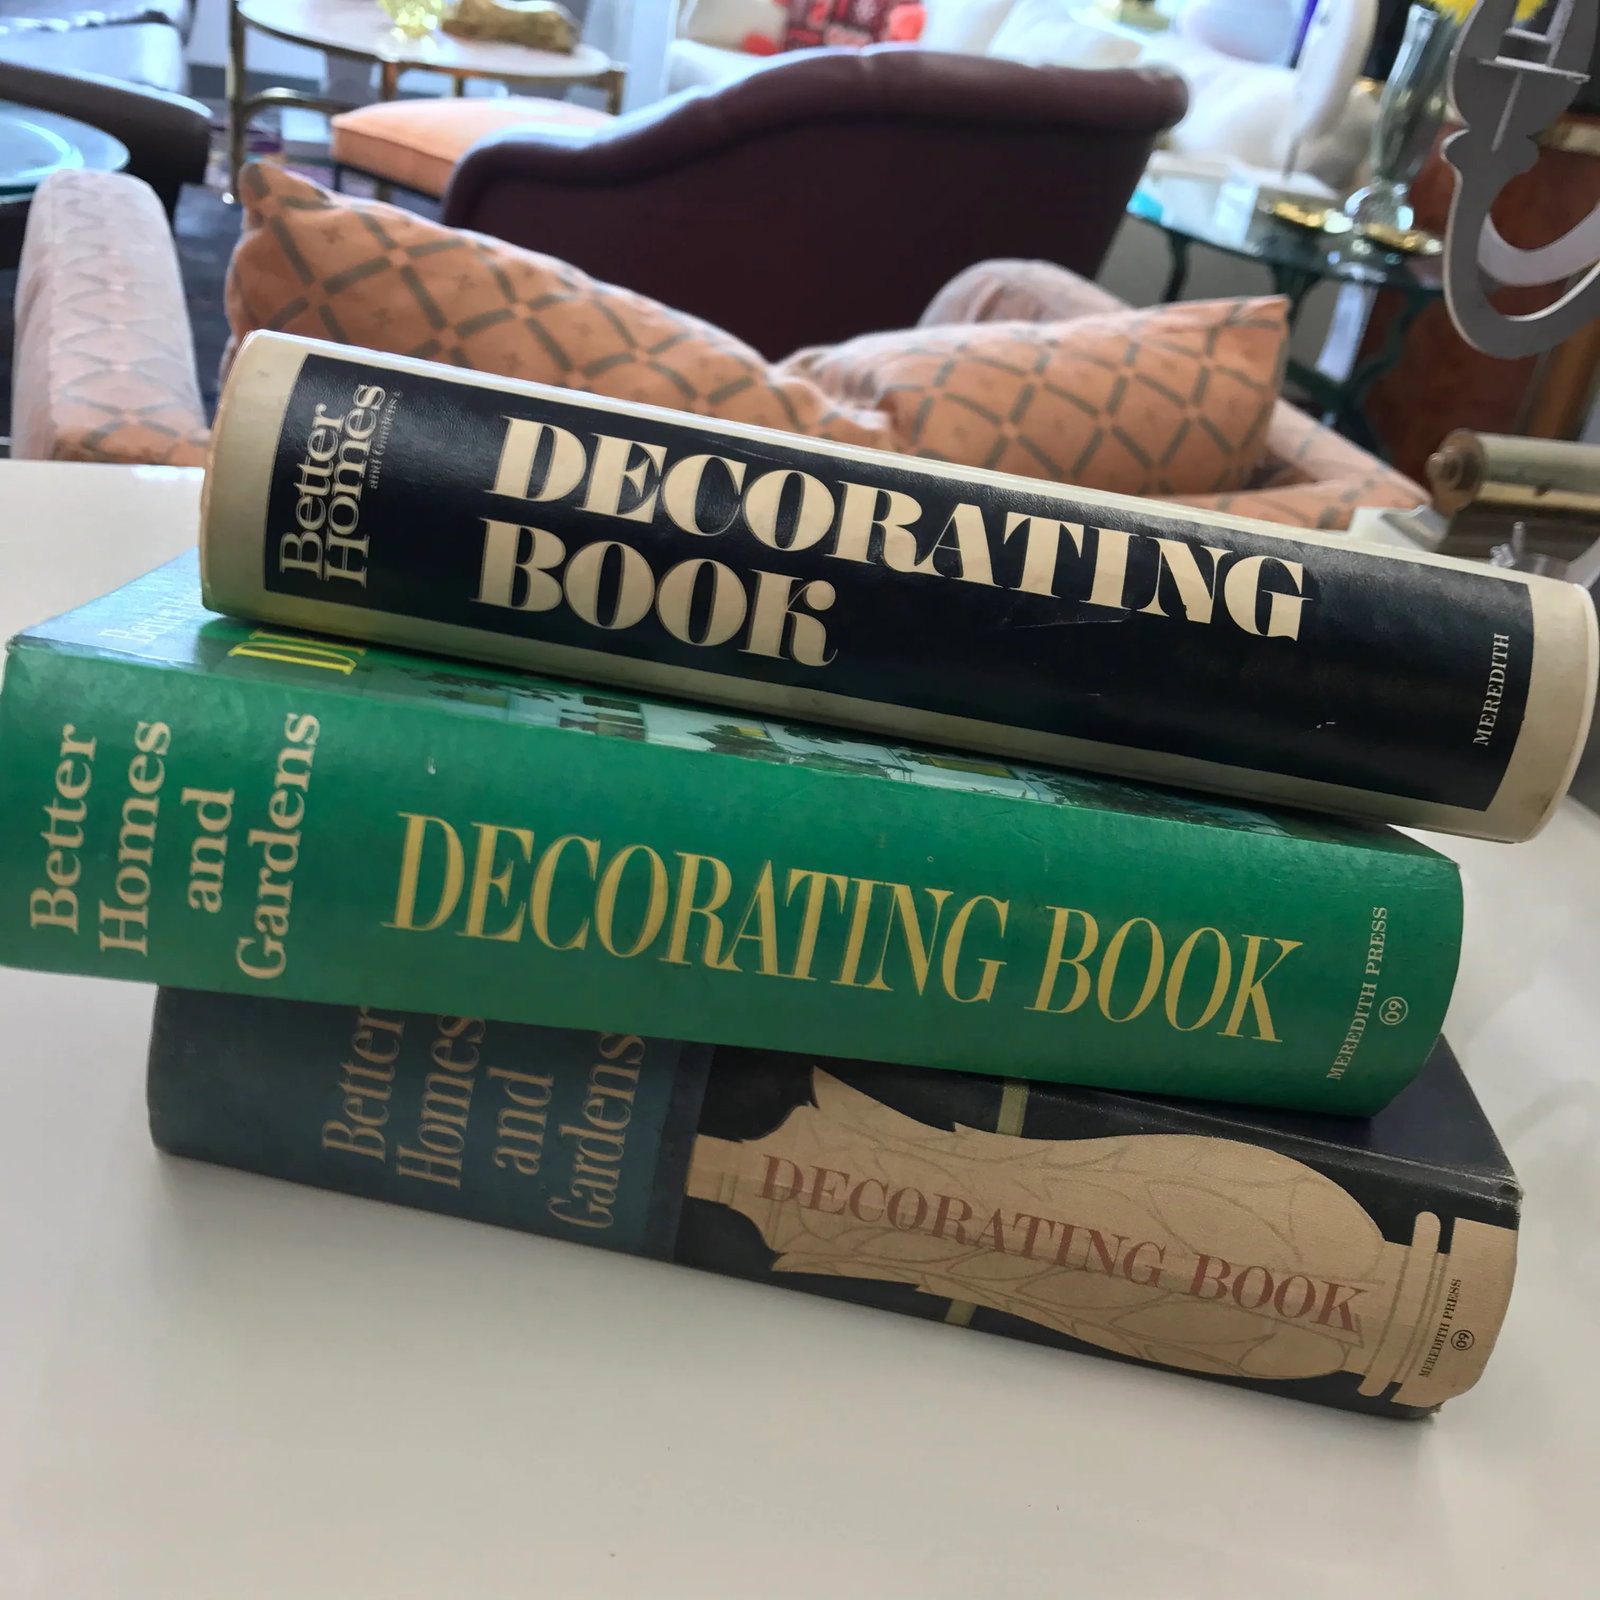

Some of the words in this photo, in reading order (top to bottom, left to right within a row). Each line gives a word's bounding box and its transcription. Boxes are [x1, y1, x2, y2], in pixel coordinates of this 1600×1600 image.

[279, 403, 345, 580] Better
[323, 383, 387, 589] Homes
[367, 457, 384, 490] and
[484, 415, 1313, 642] DECORATING
[472, 517, 838, 667] BOOK
[1472, 633, 1510, 746] MEREDITH
[29, 723, 97, 935] Better
[99, 720, 171, 956] Homes
[181, 786, 235, 914] and
[235, 712, 321, 980] Gardens
[380, 811, 1009, 1005] DECORATING
[1023, 905, 1303, 1044] BOOK
[1326, 981, 1378, 1081] MEREDITH
[1364, 906, 1388, 977] PRESS
[321, 1005, 405, 1165] Better
[395, 1013, 486, 1191] Homes
[486, 1065, 554, 1177] and
[547, 1031, 647, 1229] Gardens
[755, 1154, 1167, 1289] DECORATING
[1188, 1252, 1369, 1333] BOOK
[1418, 1321, 1451, 1379] MEREDITH
[1442, 1277, 1462, 1321] PRESS
